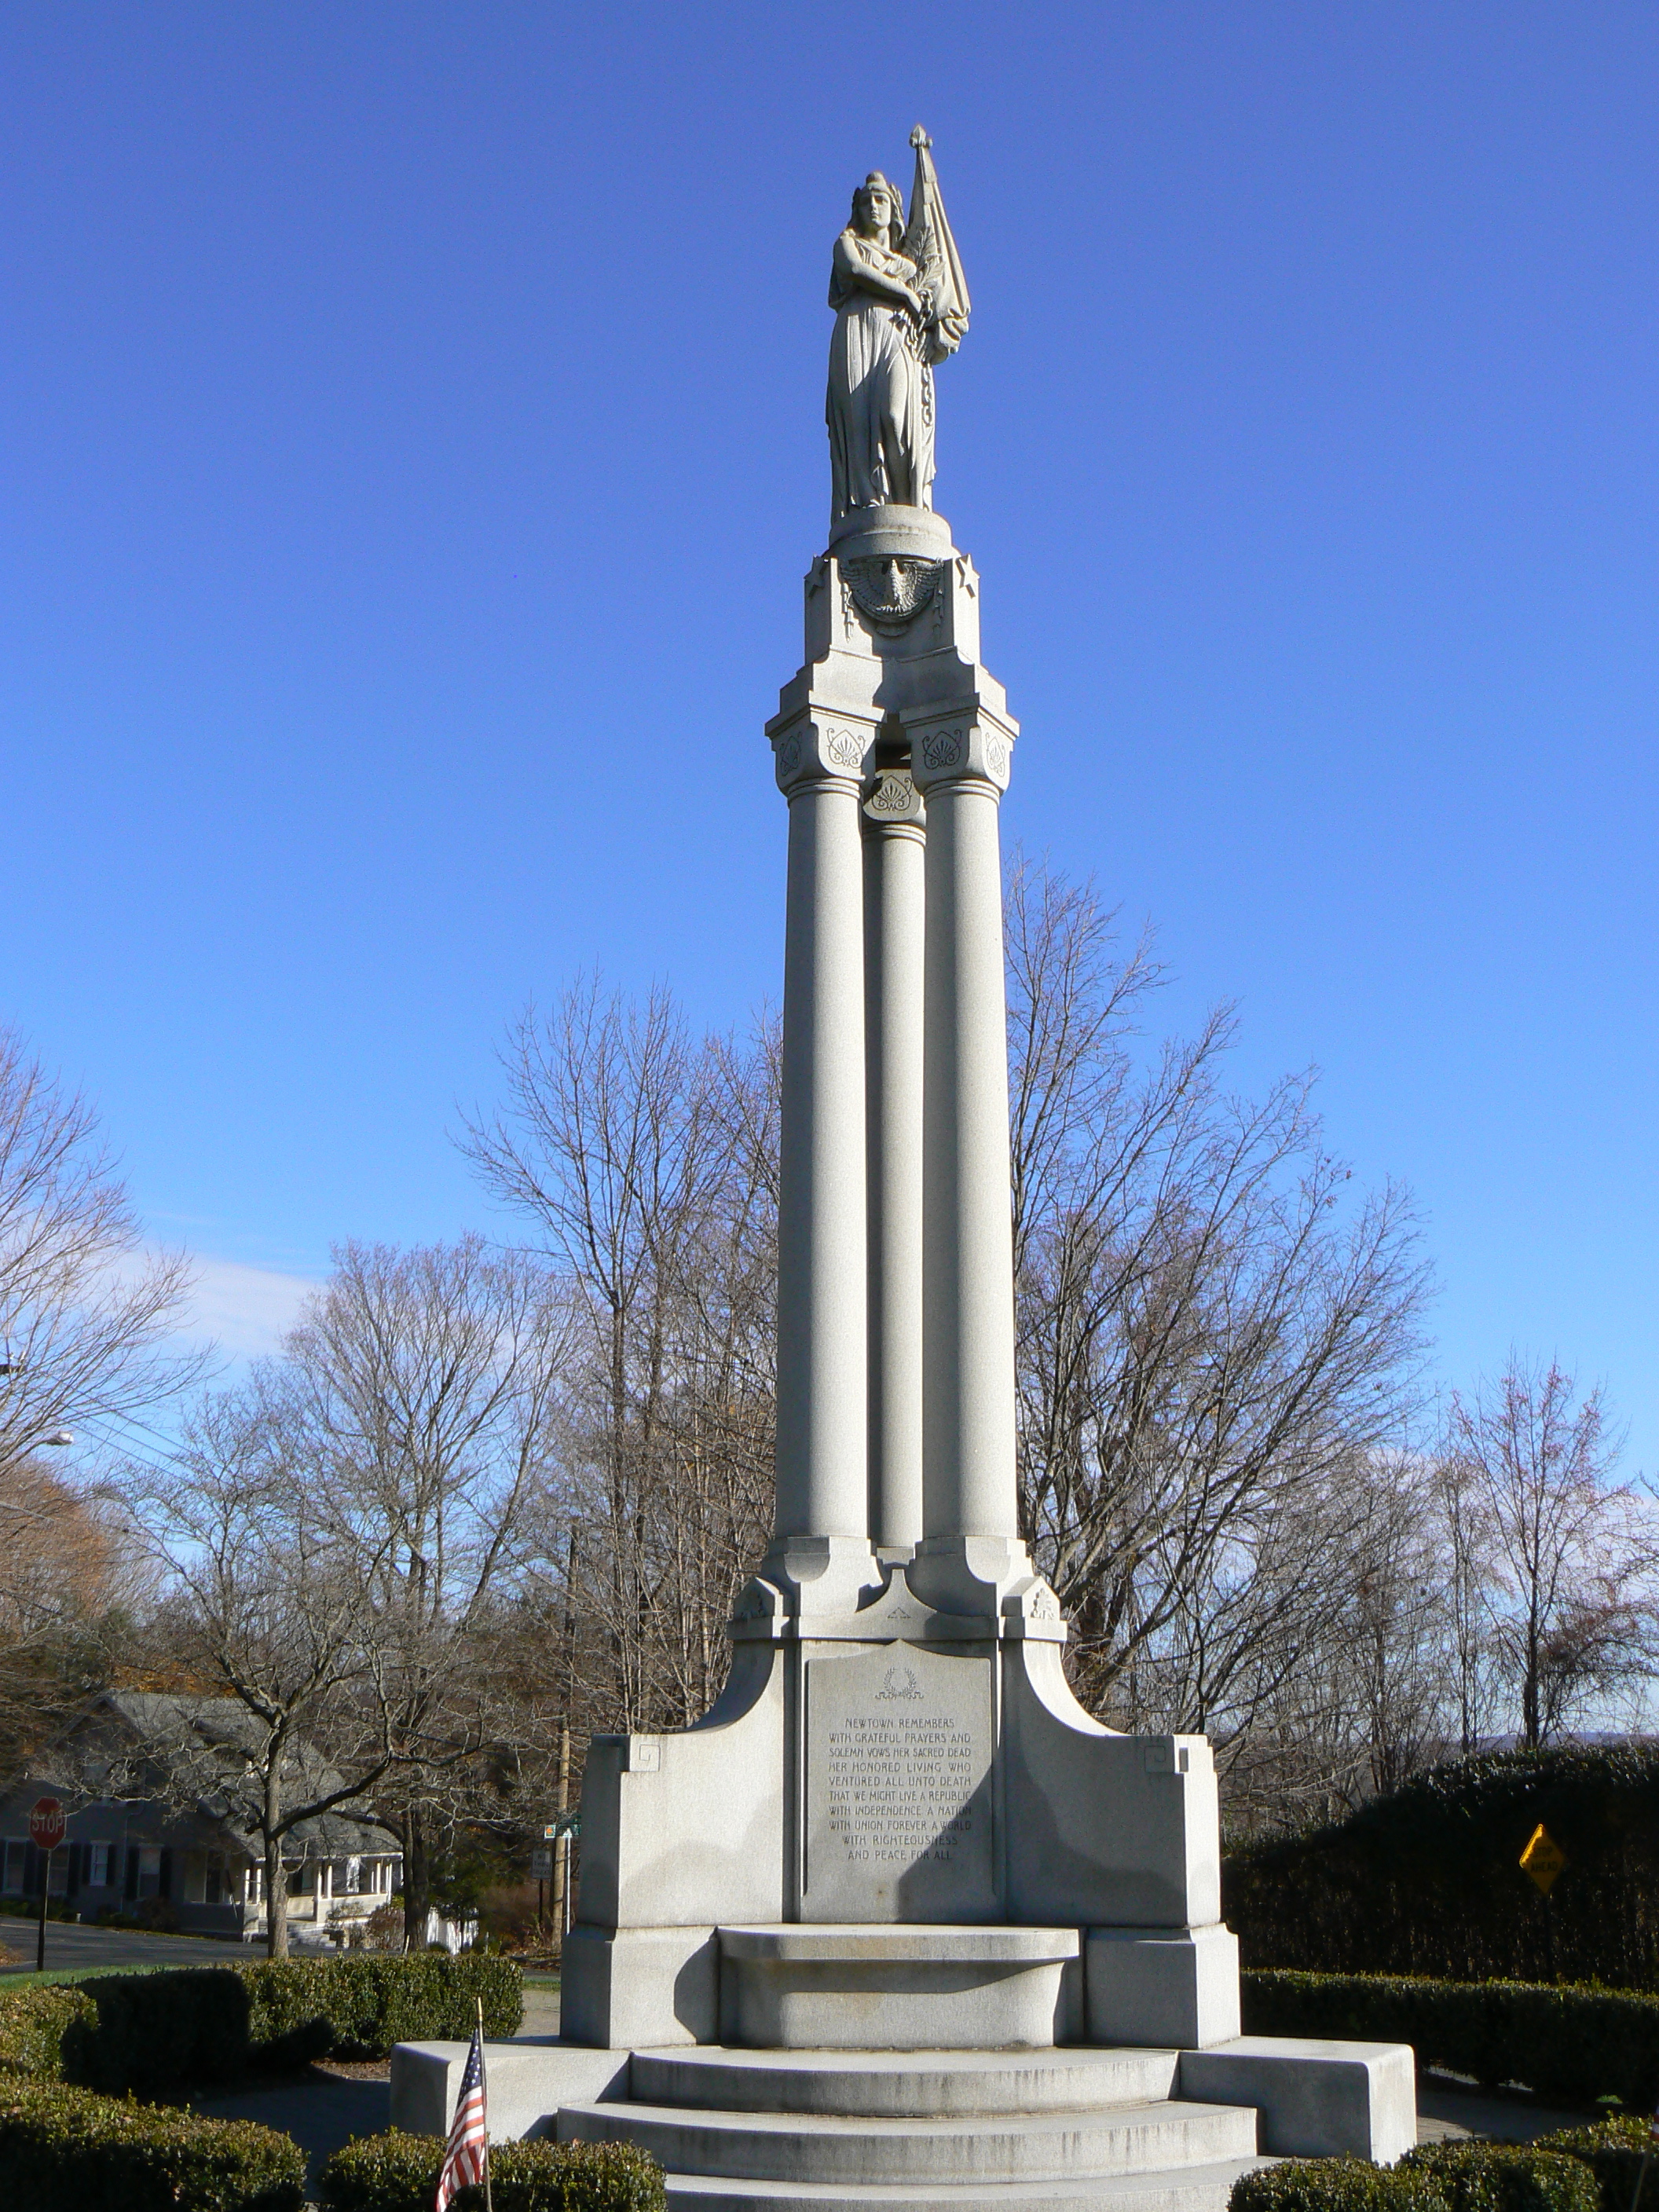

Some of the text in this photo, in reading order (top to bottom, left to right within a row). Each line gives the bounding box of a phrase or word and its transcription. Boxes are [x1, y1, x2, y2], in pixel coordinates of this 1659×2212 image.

[845, 1718, 954, 1729] NEWTOWN REMEMBERS
[829, 1733, 970, 1743] WITH GRATEFUL PRAYERS AND
[829, 1748, 971, 1757] SOLEMN VOWS HER SACRED DEAD
[829, 1762, 971, 1772] HER HONORED LIVING WHO
[829, 1777, 971, 1786] VENTURED ALL UNTO DEATH
[830, 1791, 971, 1801] THAT WE MIGHT LIVE A REPUBLIC
[829, 1806, 971, 1816] WITH INDEPENDENCE A NATION
[32, 1813, 63, 1833] STOP
[829, 1820, 971, 1830] WITH UNION FOREVER A WORLD
[842, 1835, 958, 1845] WITH RIGHTEOUSNESS
[848, 1850, 952, 1860] AND PEACE FOR ALL
[1531, 1862, 1558, 1872] AHEAD
